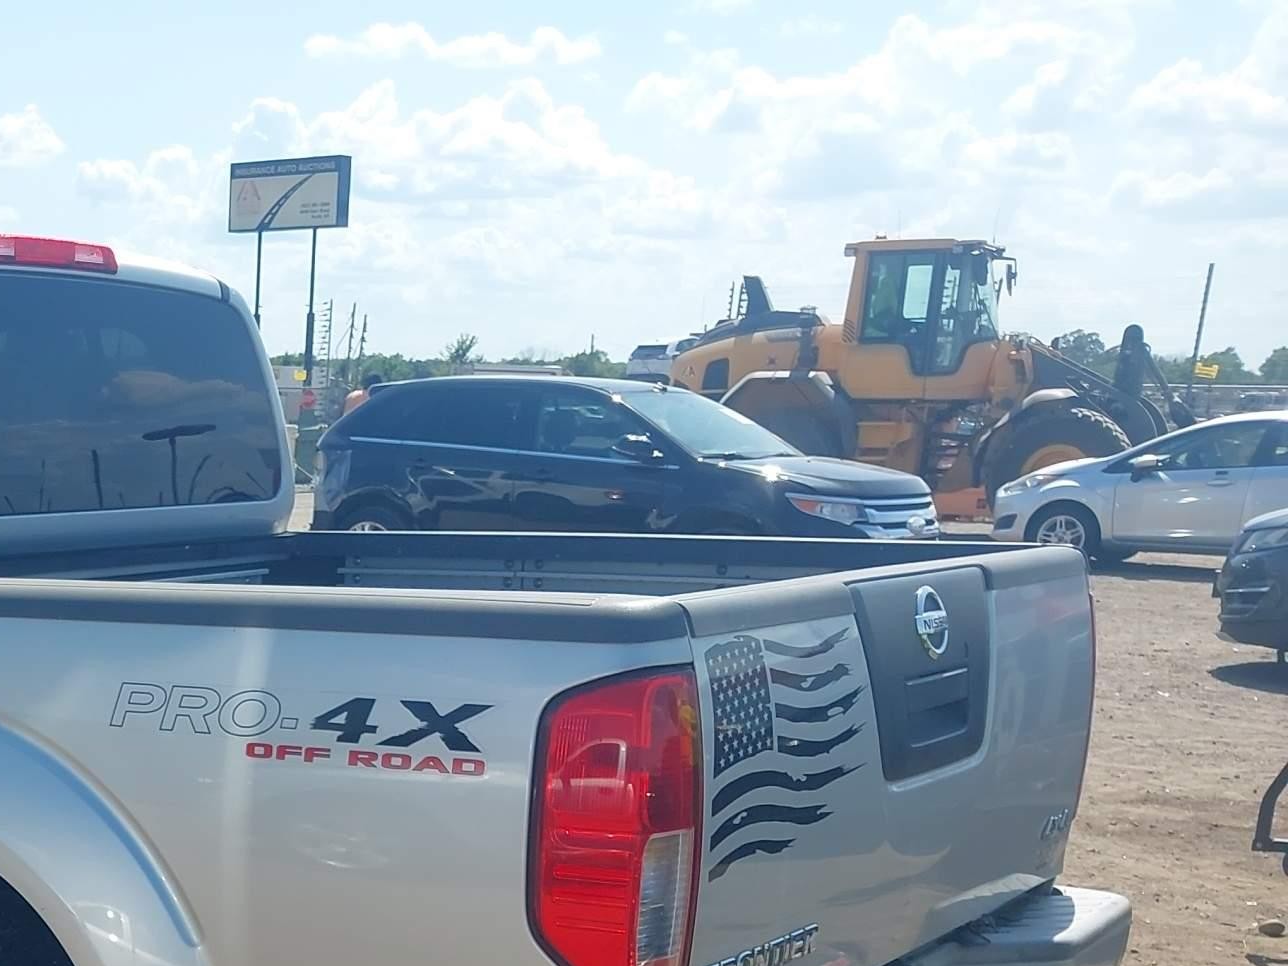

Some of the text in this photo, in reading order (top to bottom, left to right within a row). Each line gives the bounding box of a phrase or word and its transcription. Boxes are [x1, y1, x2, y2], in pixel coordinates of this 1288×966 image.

[277, 163, 296, 172] AUTO
[245, 742, 488, 777] OFF ROAD
